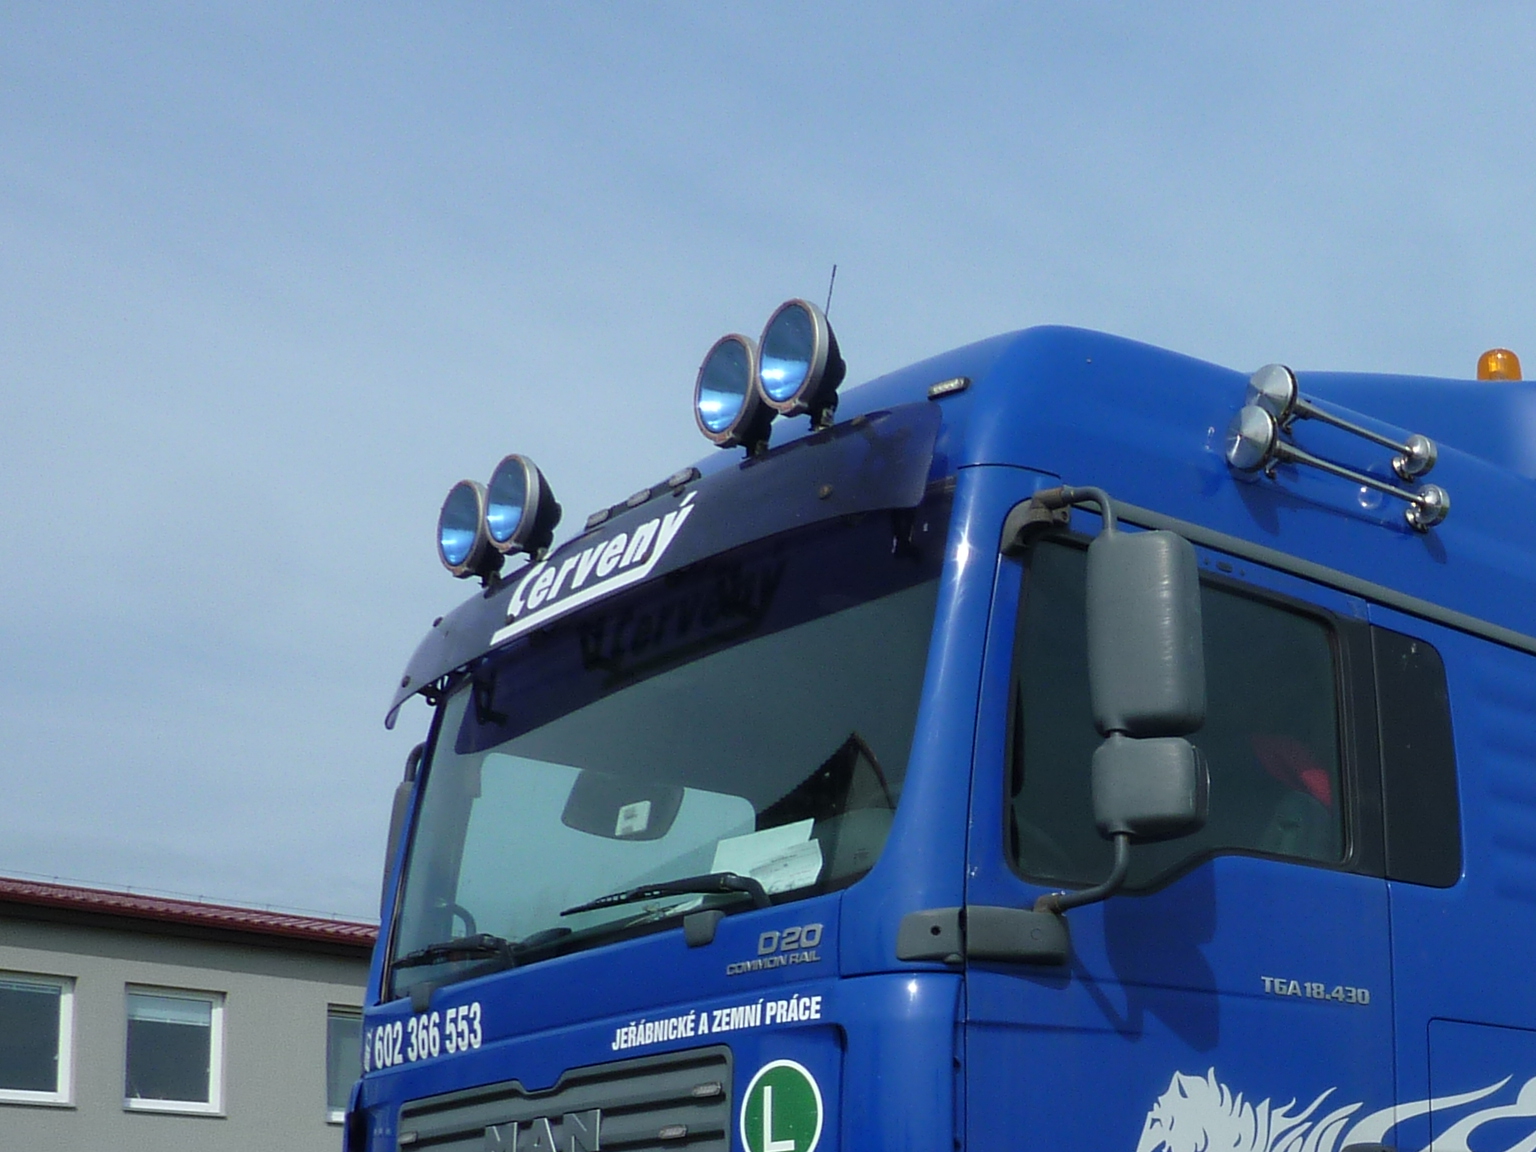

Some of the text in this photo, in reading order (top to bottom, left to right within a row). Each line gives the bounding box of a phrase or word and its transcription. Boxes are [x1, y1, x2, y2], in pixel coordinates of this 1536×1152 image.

[757, 923, 824, 955] D20
[726, 950, 821, 976] COMMON RAIL
[374, 1002, 482, 1070] 602 366 553
[611, 993, 822, 1051] JEŘÁBNICKÉ A ZEMNÍ PRÁCE
